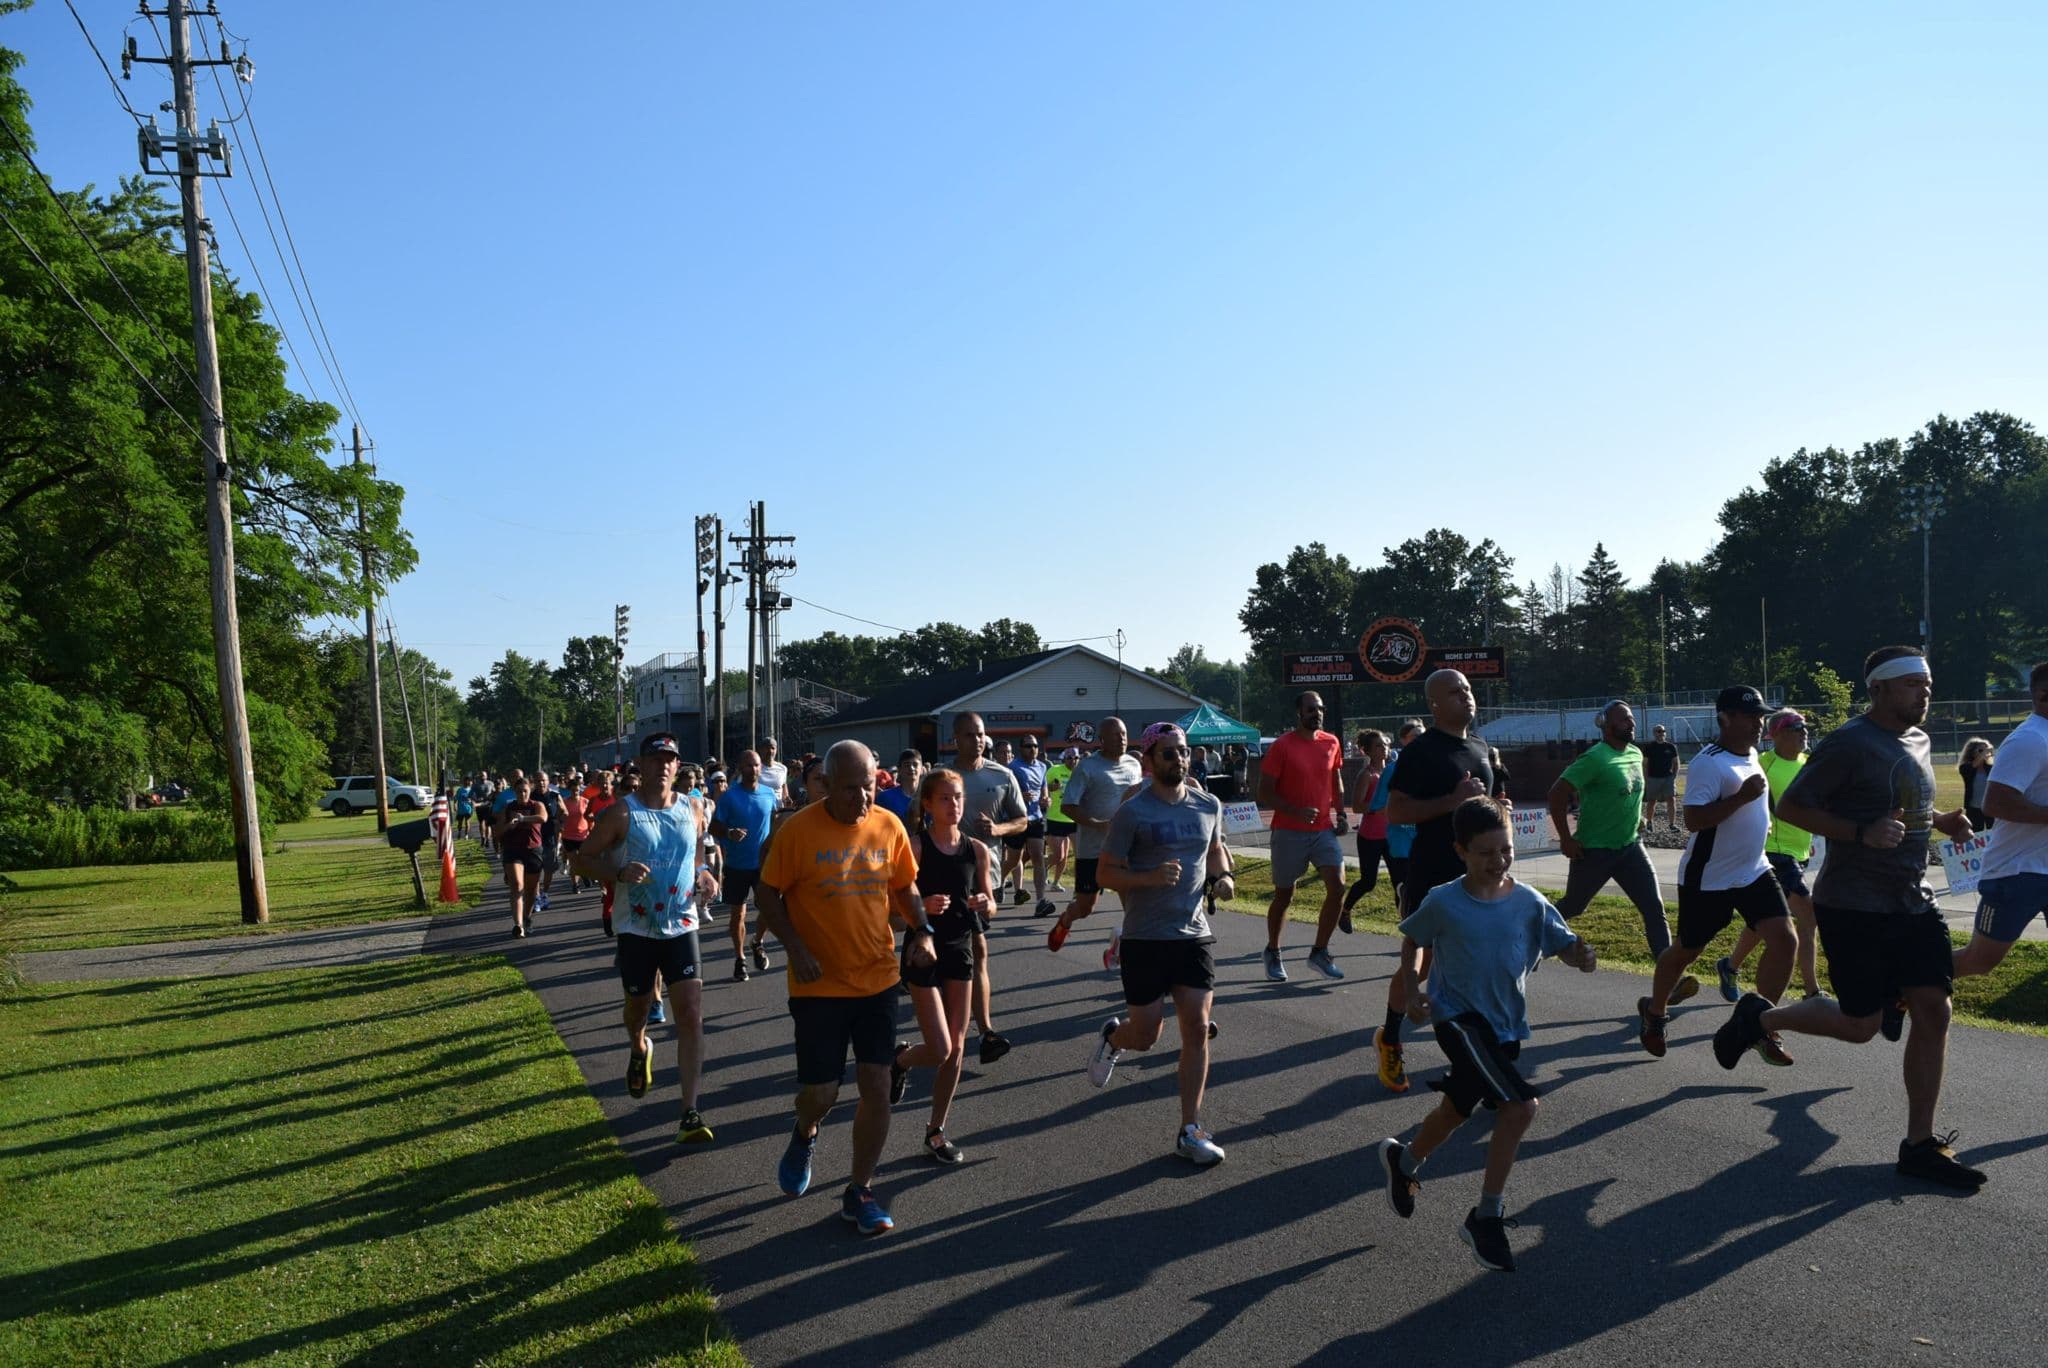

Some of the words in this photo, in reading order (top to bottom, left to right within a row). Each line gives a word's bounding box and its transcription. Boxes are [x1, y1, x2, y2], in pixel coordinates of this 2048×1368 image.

[1299, 655, 1333, 663] WELCOME
[1332, 673, 1354, 682] FIELD
[1234, 813, 1251, 822] YOU
[1516, 825, 1535, 835] YOU
[1960, 857, 1982, 872] YO
